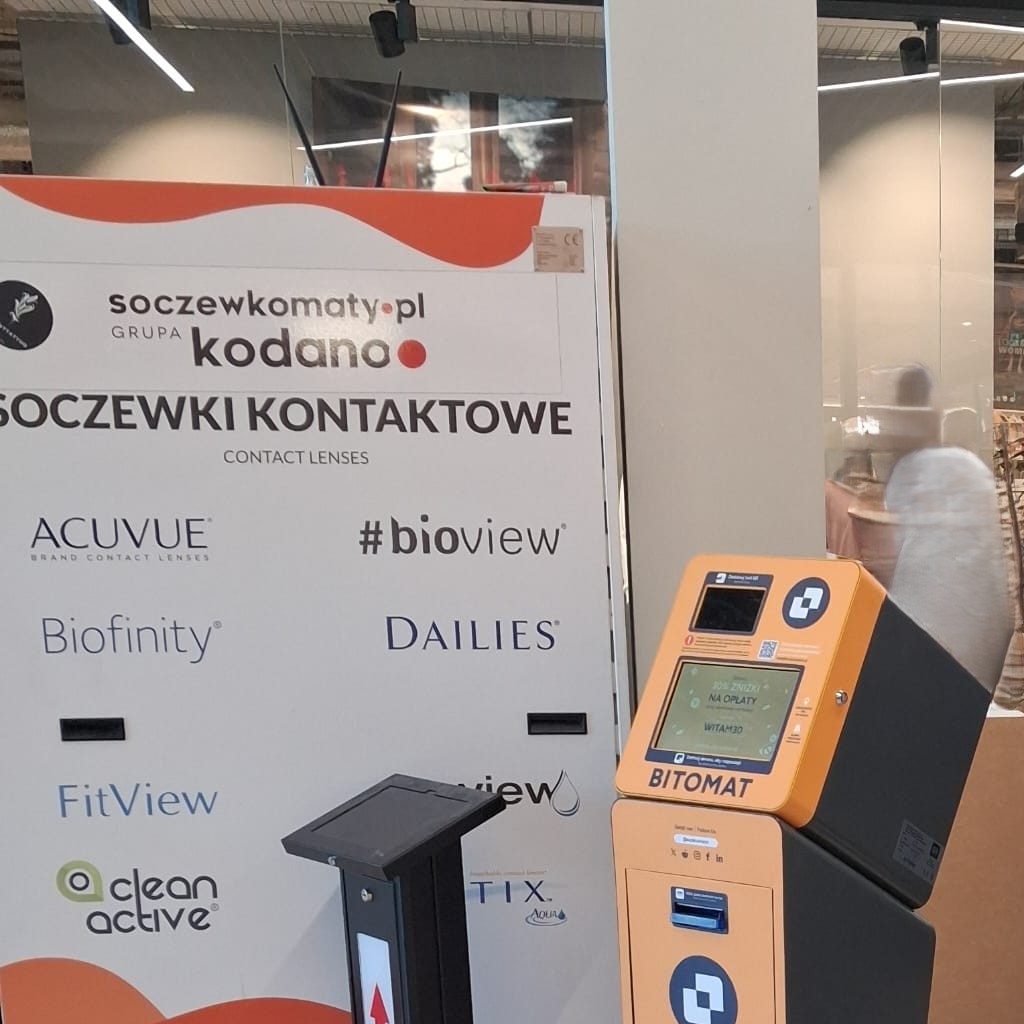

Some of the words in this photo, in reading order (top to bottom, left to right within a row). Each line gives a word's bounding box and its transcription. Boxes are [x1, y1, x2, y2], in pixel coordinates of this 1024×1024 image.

[111, 326, 182, 339] GRUPA
[191, 326, 391, 369] kodano
[247, 396, 573, 436] KONTAKTOWE
[223, 450, 304, 464] CONTACT
[309, 451, 369, 465] LENSES
[30, 516, 209, 550] ACUVUE
[30, 554, 78, 562] BRAND
[86, 554, 150, 562] CONTACT
[158, 554, 209, 562] LENSES
[42, 614, 212, 664] Biofinity
[648, 768, 754, 798] BITOMAT
[58, 783, 218, 818] FitView
[86, 902, 212, 935] active
